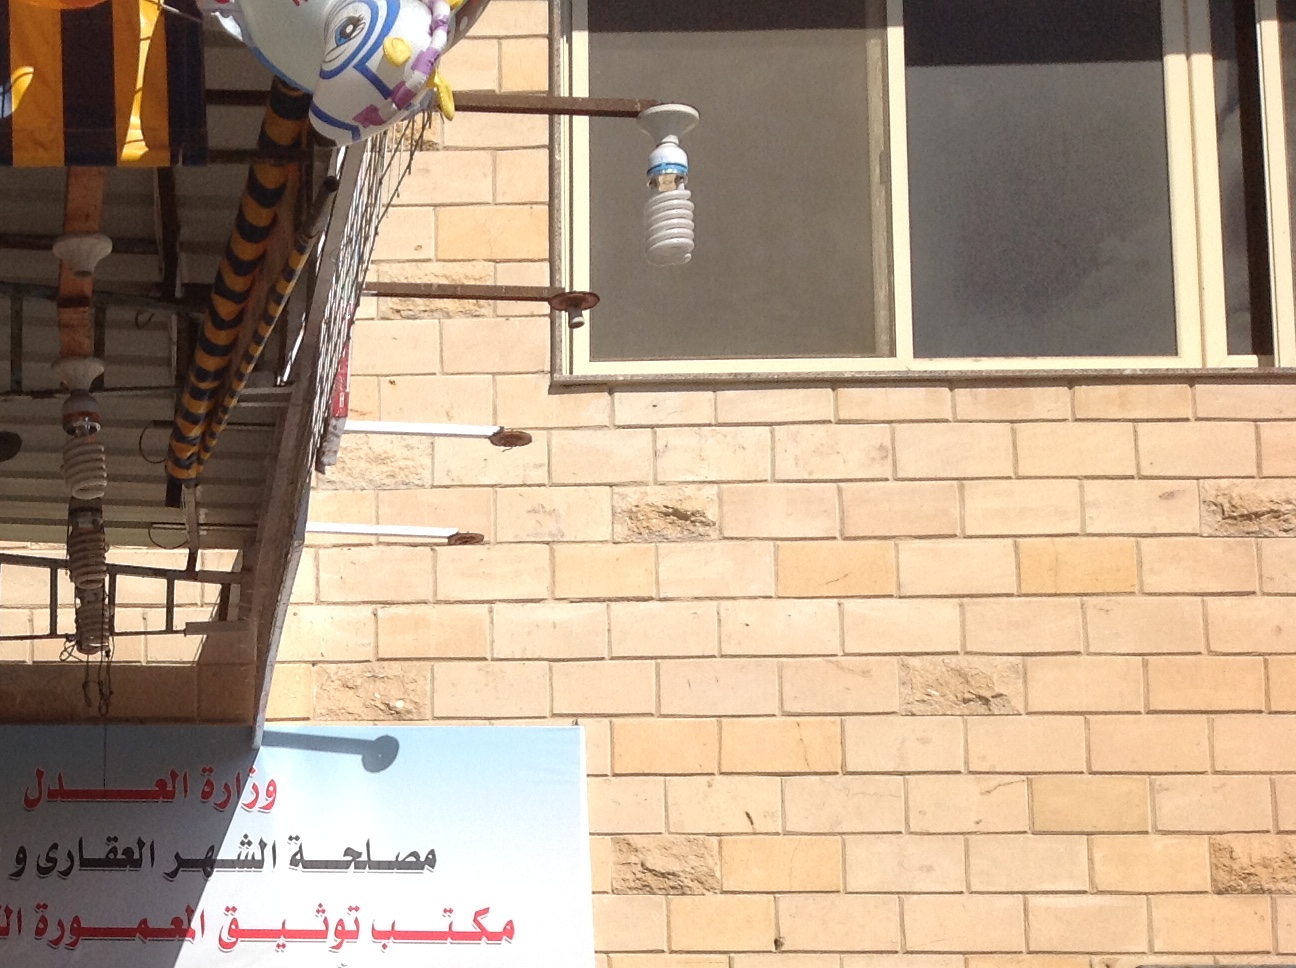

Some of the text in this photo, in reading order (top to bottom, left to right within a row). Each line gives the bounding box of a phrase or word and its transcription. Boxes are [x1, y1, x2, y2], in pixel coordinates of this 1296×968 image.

[23, 766, 278, 811] وزارة العدل
[8, 844, 28, 879] و
[162, 833, 277, 880] الشهر
[288, 834, 438, 872] مصلحة
[34, 902, 206, 949] المعمورة
[218, 903, 361, 952] توثيق
[371, 906, 516, 952] مكتب
